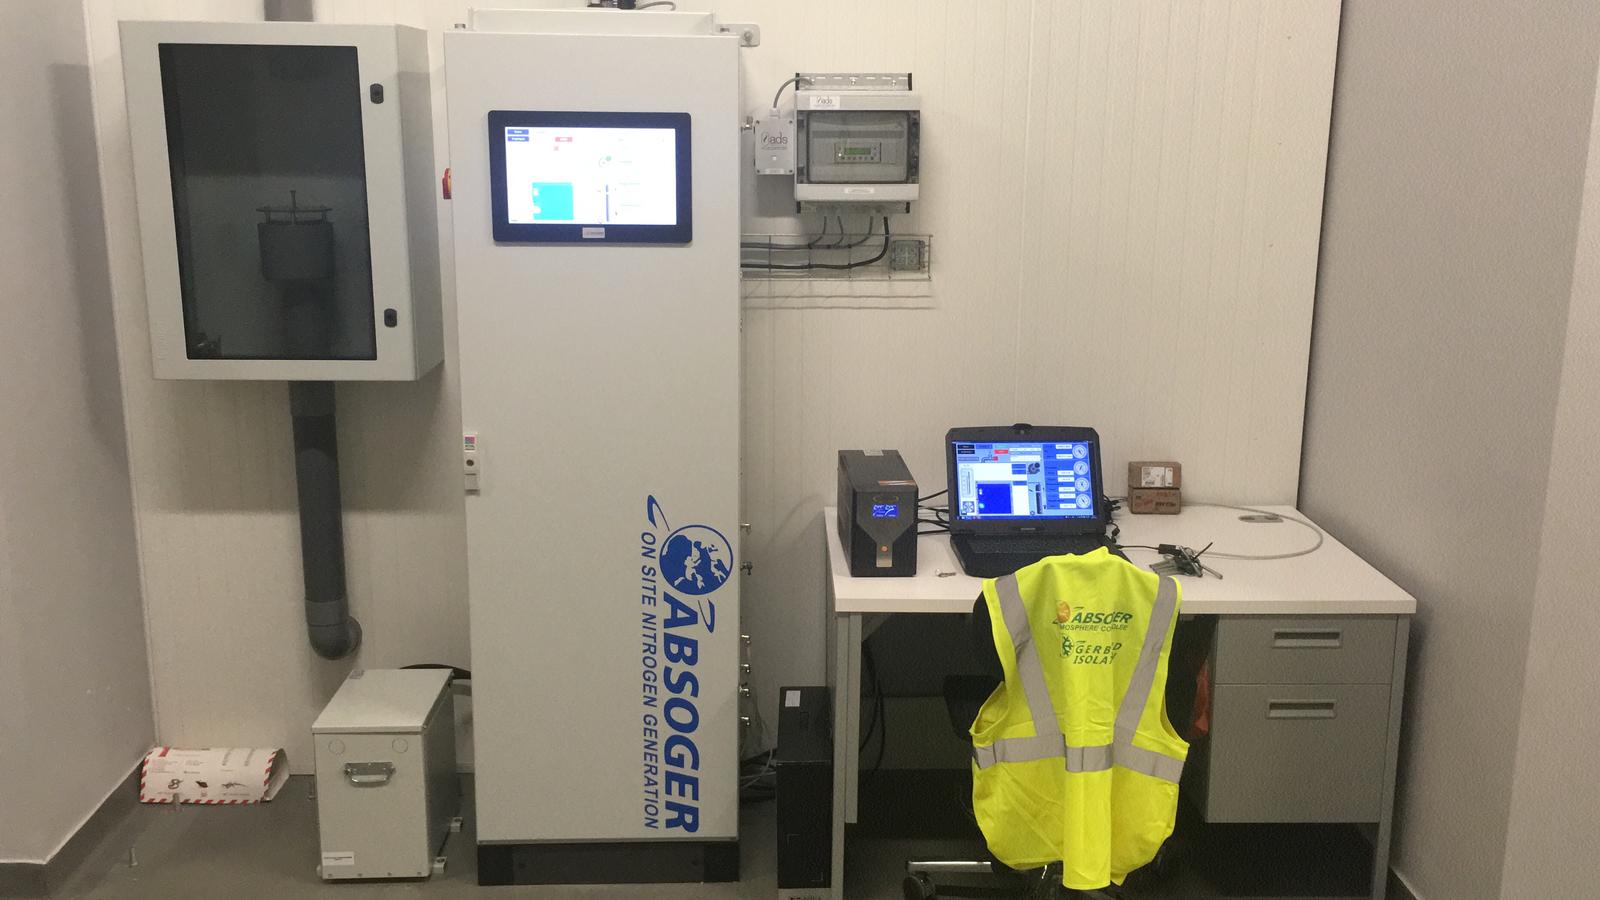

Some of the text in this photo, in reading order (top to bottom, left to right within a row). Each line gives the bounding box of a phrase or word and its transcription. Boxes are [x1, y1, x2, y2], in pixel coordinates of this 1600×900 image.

[641, 531, 659, 830] ON SITE NITROGEN GENERATION
[1071, 612, 1133, 624] ABSOER
[1075, 643, 1122, 655] GERBD
[663, 591, 700, 834] ABSOGER
